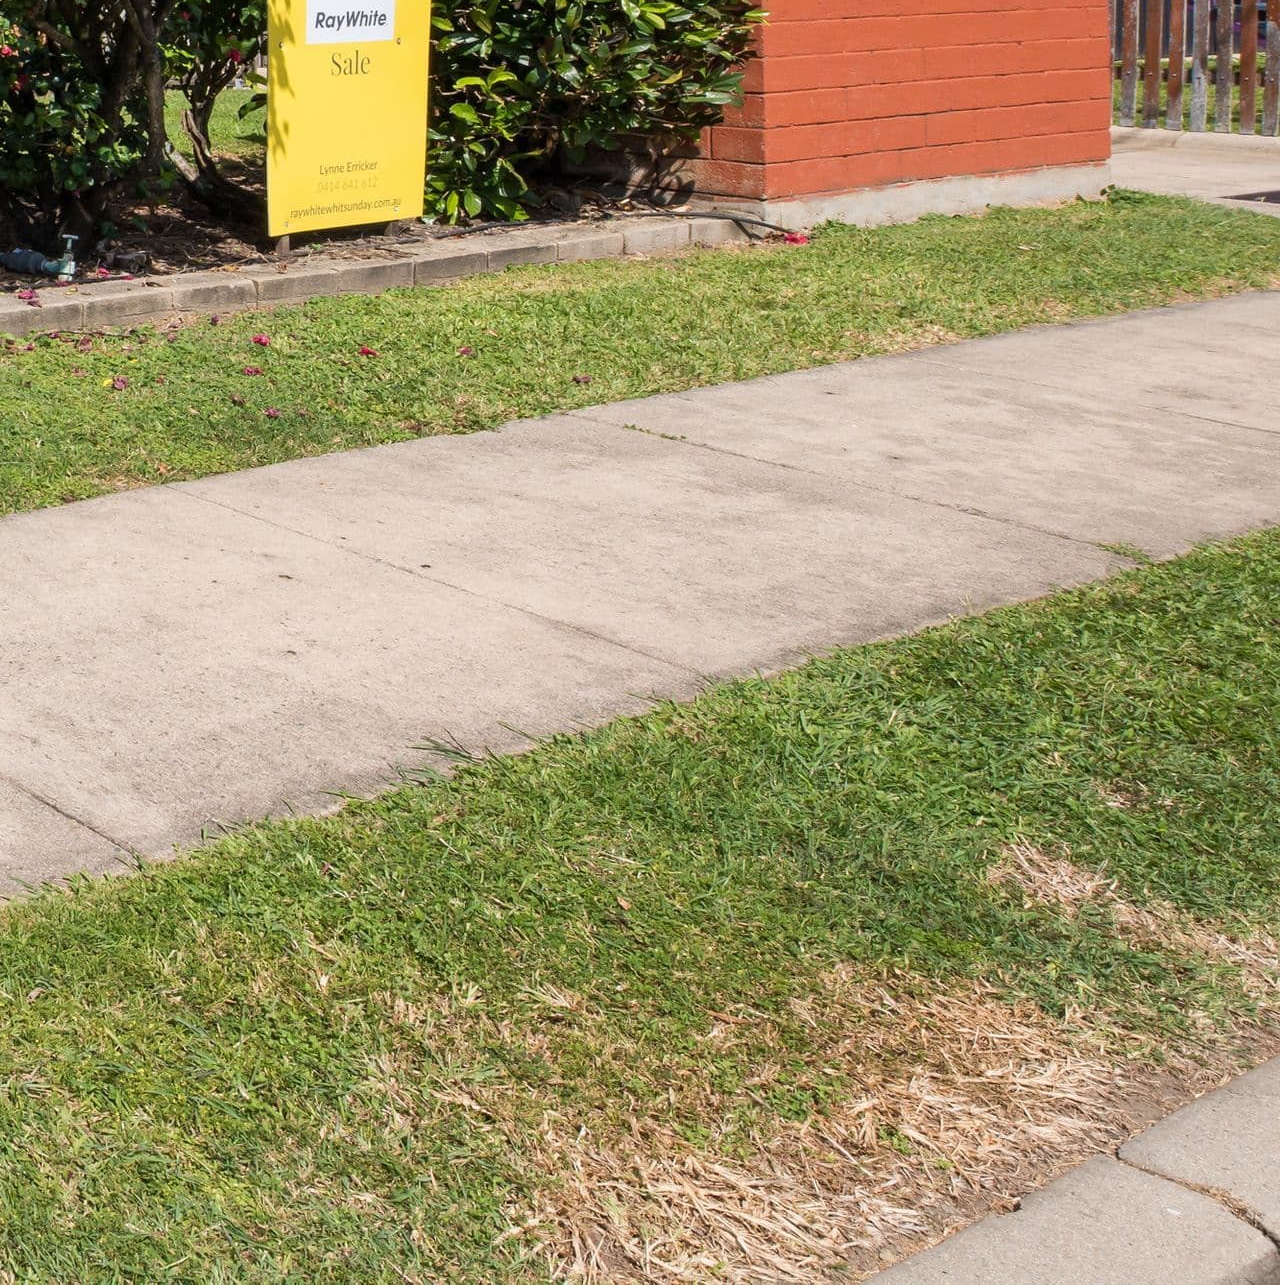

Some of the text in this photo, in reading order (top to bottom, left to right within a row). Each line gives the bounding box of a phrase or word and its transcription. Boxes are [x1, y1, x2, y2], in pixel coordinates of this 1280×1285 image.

[331, 50, 370, 76] Sale
[319, 161, 378, 177] Lynne Erricker
[291, 197, 401, 218] raywhitewhitsunday.com.au
